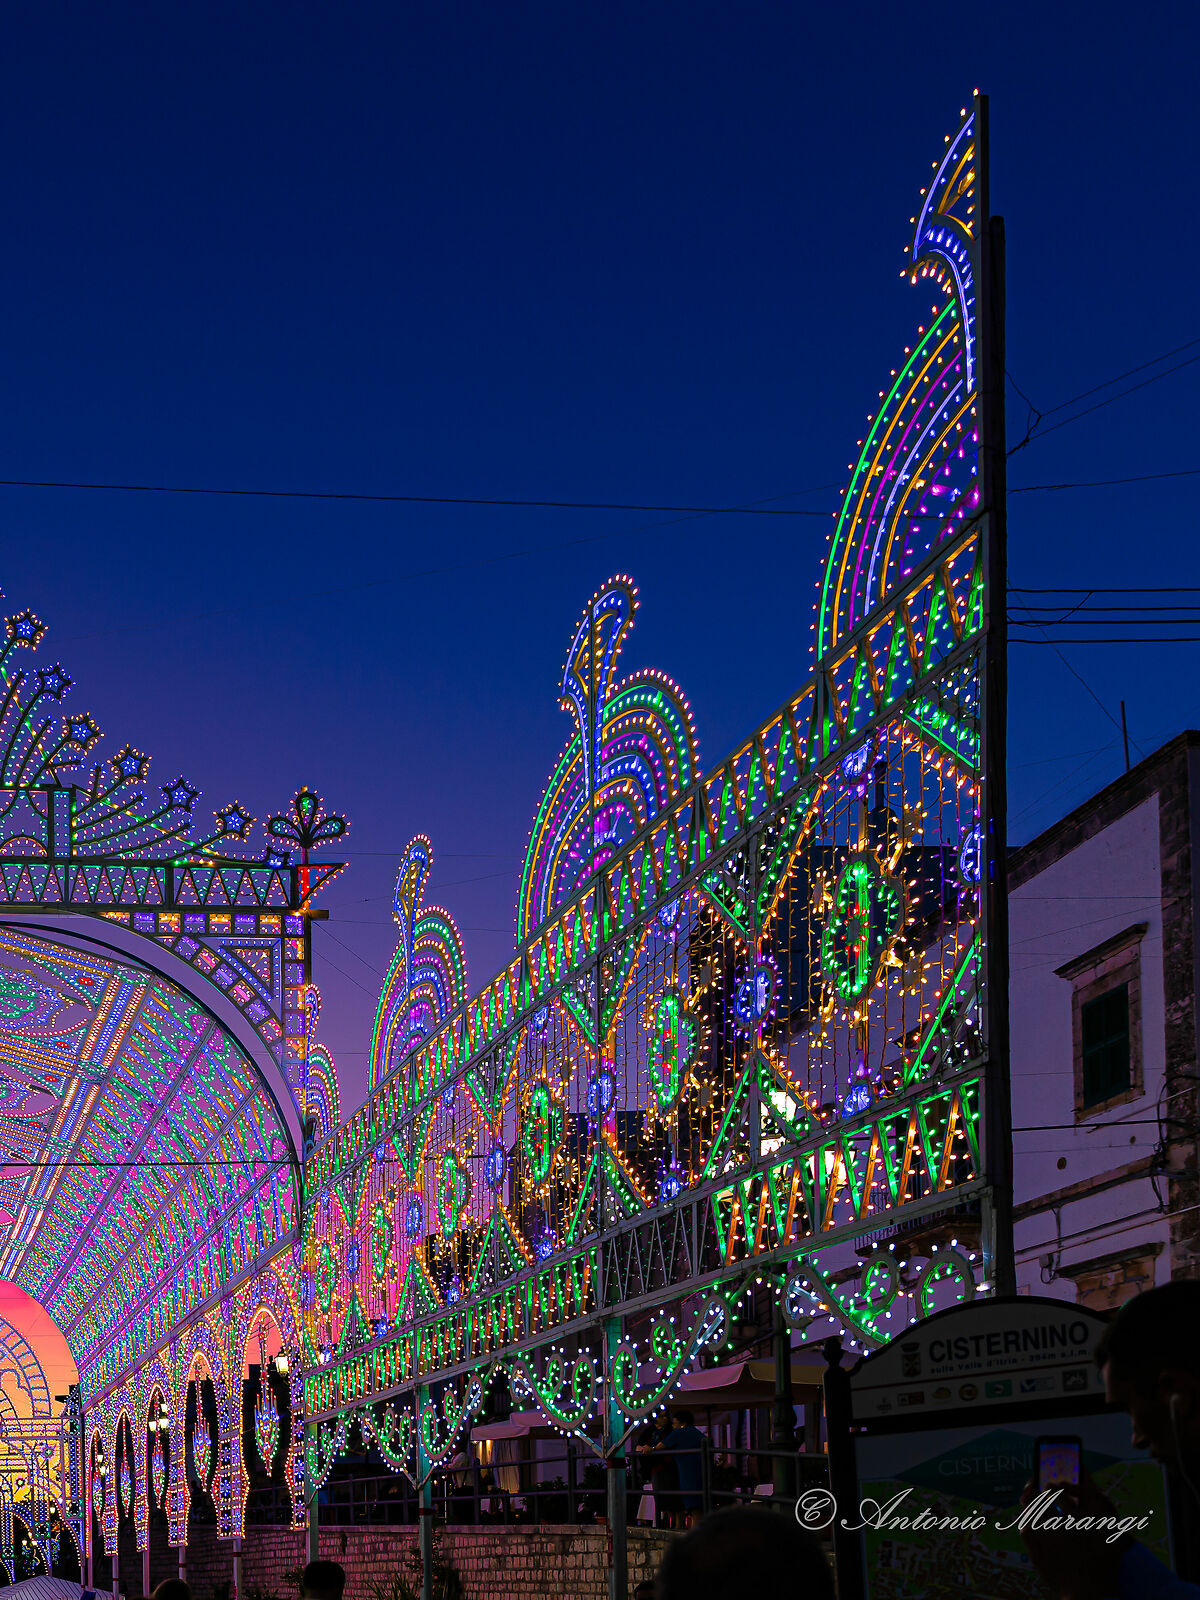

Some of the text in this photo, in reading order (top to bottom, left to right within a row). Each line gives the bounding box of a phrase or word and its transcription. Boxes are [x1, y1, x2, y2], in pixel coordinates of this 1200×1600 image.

[929, 1321, 1088, 1362] CISTERNINO
[959, 1361, 982, 1371] Valle
[938, 1453, 1034, 1475] CISTERNI
